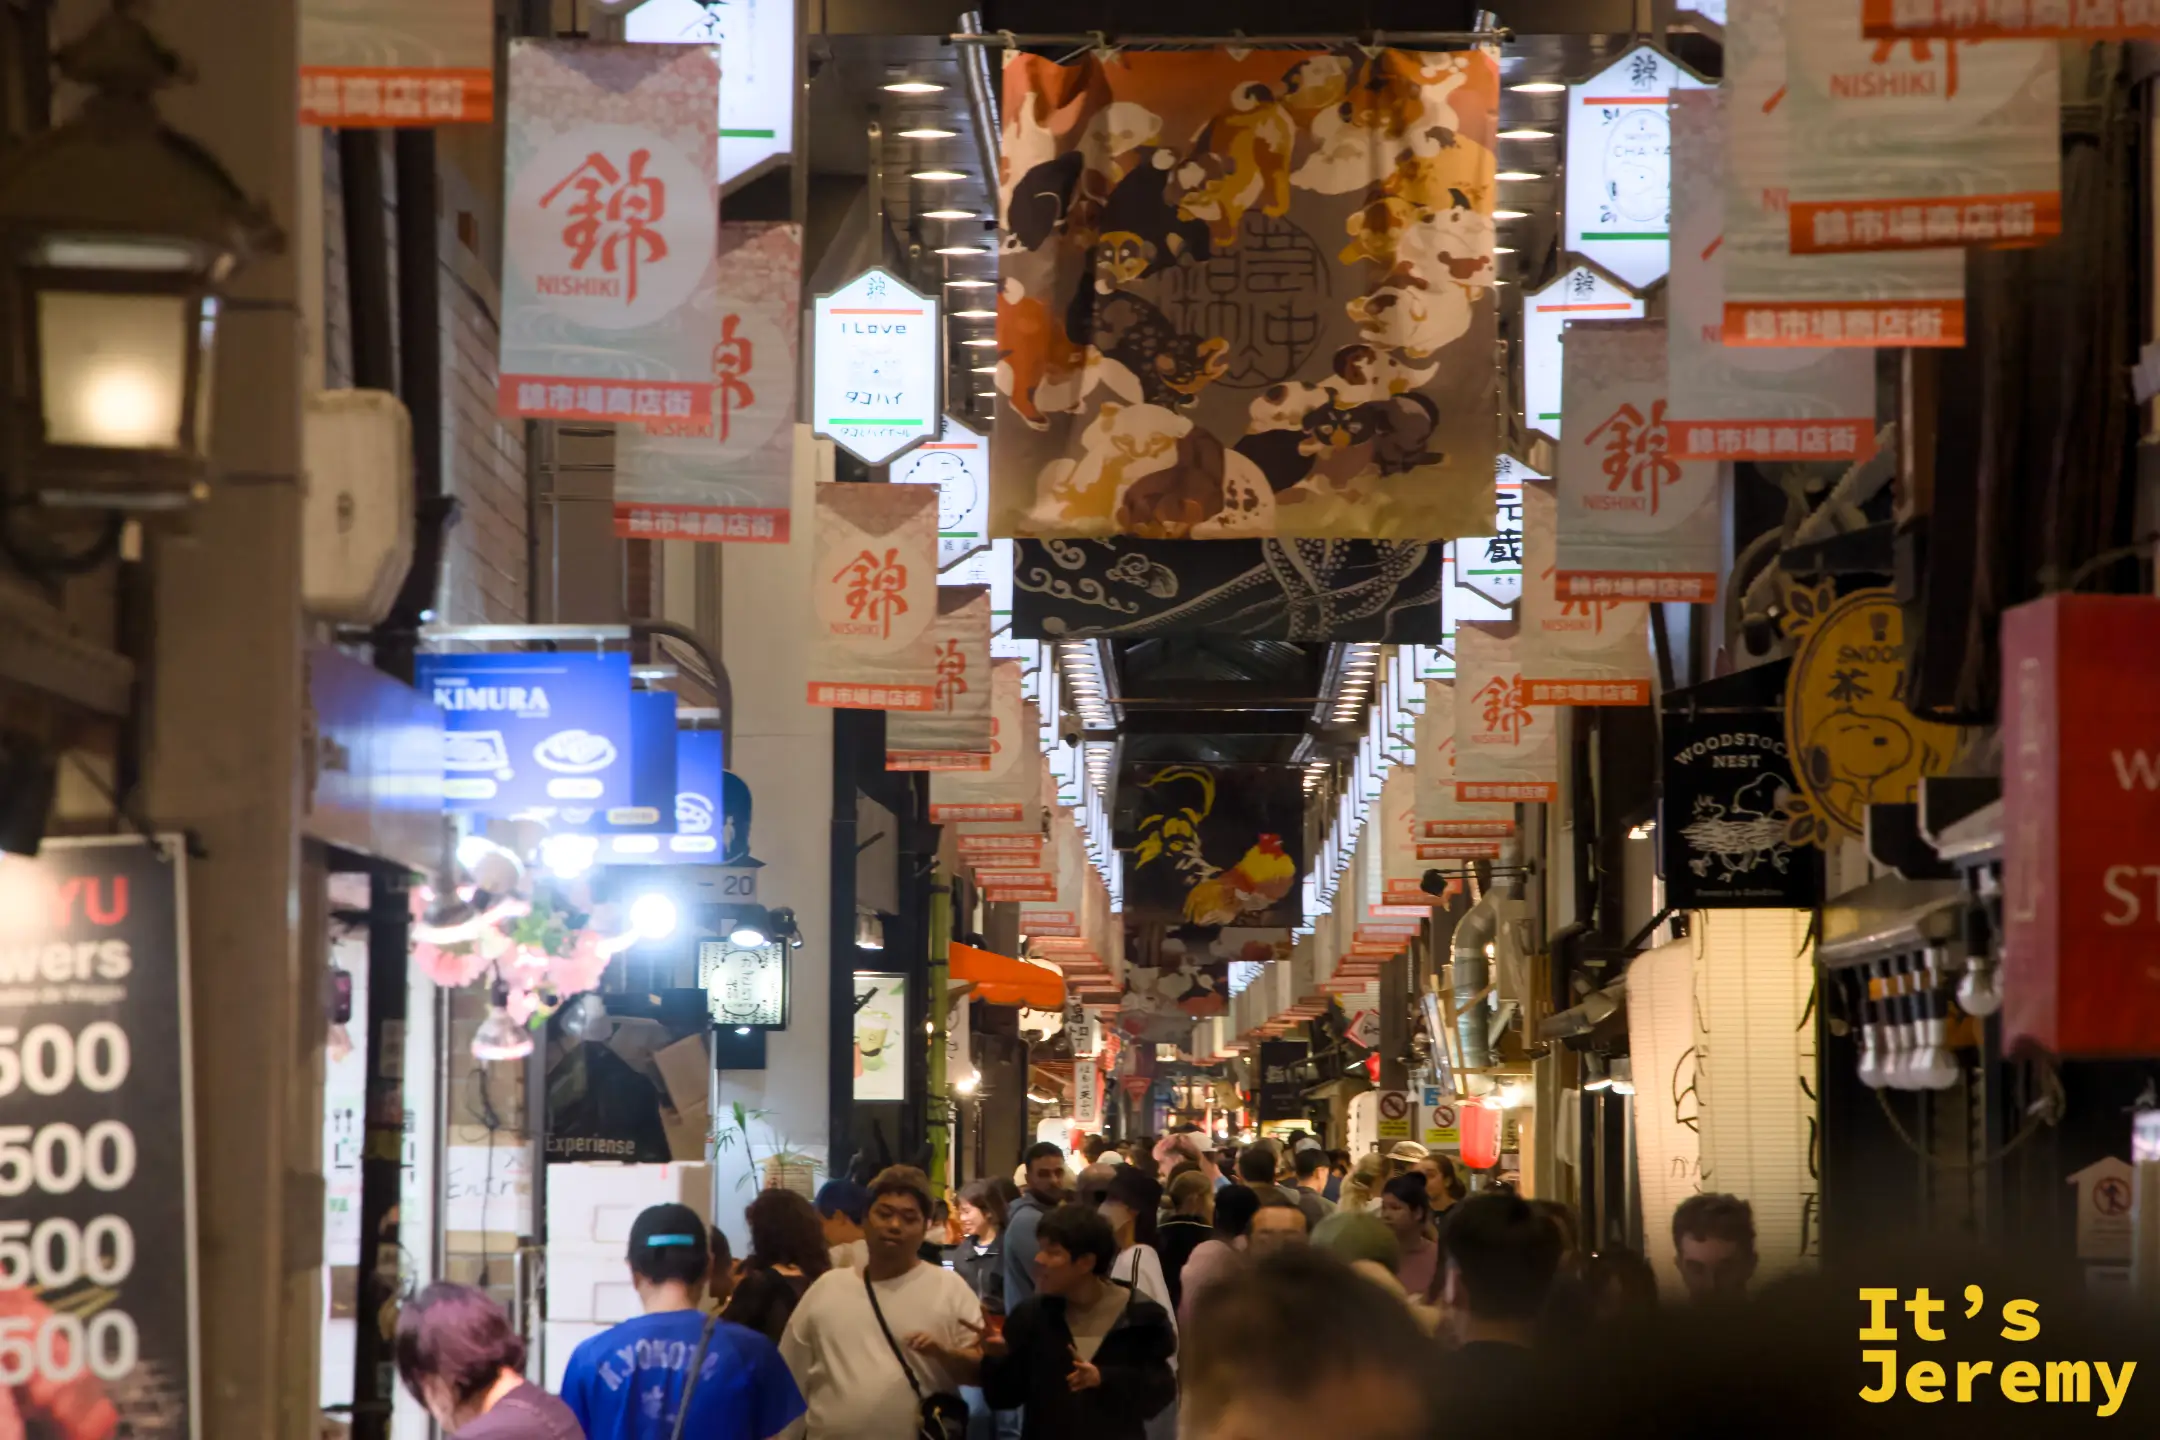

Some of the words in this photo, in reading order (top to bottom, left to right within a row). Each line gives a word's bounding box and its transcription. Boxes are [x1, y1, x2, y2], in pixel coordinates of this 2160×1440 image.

[1829, 71, 1937, 98] NISHIKI
[539, 148, 669, 306] 錦
[536, 274, 621, 297] NISHIKI
[855, 323, 907, 334] Love
[516, 382, 693, 418] 錦市場商店街
[832, 548, 909, 640] 錦
[434, 686, 549, 712] KIMURA
[1673, 733, 1789, 765] WOODSTOC
[1712, 755, 1761, 768] NEST
[724, 875, 753, 895] 20
